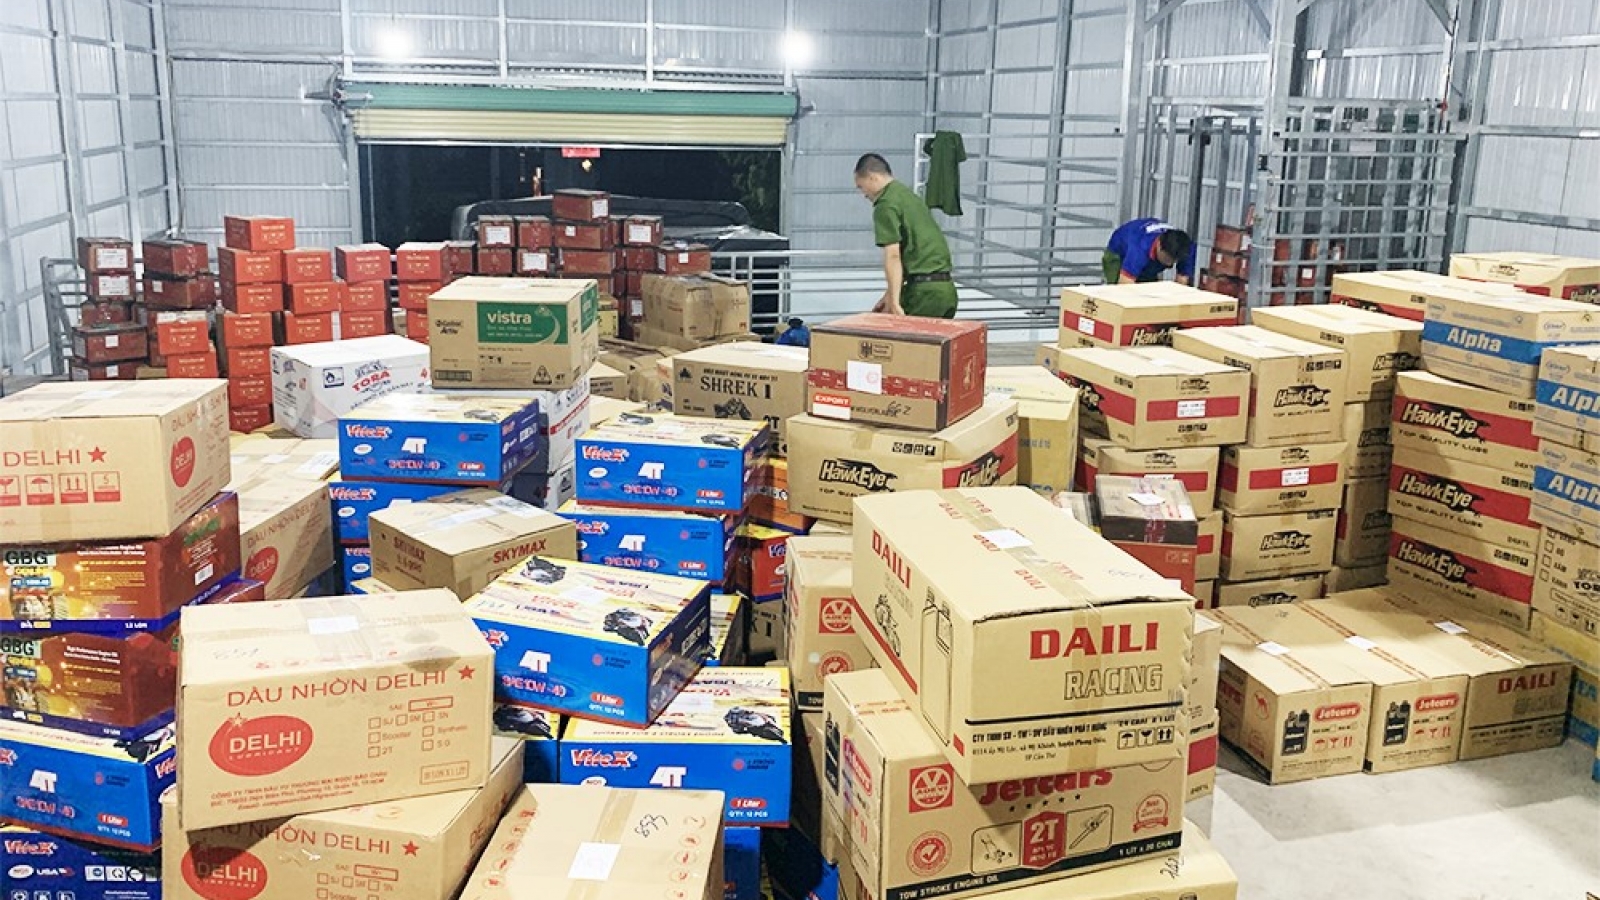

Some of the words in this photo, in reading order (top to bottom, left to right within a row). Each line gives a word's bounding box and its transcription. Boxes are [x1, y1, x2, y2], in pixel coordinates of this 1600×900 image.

[487, 311, 532, 324] vistra
[1447, 327, 1502, 353] Alpha
[352, 369, 391, 392] TORA
[701, 376, 758, 397] SHREK
[815, 395, 849, 405] EXPORT
[1402, 403, 1478, 434] HawkEye
[4, 449, 80, 466] DELHI
[820, 459, 887, 488] HawkEye
[1400, 473, 1473, 508] HawkEye
[5, 550, 48, 564] GBG
[493, 538, 546, 564] SKYMAX
[872, 529, 911, 588] DAILI
[1397, 542, 1467, 578] HawkEye
[1, 638, 34, 655] GBG
[1030, 622, 1158, 660] DAILI
[375, 669, 447, 692] DELHI
[1064, 663, 1163, 700] RACING
[1498, 671, 1557, 694] DAILI
[1319, 707, 1356, 718] Jetcars
[1419, 698, 1454, 709] Jetcars
[229, 730, 301, 754] DELHI
[325, 832, 390, 854] DELHI
[1031, 819, 1059, 844] 2T
[197, 861, 258, 882] DELHI
[899, 891, 918, 900] TOW
[920, 884, 951, 897] STROKE
[954, 878, 984, 890] ENGINE
[987, 874, 999, 883] OIL
